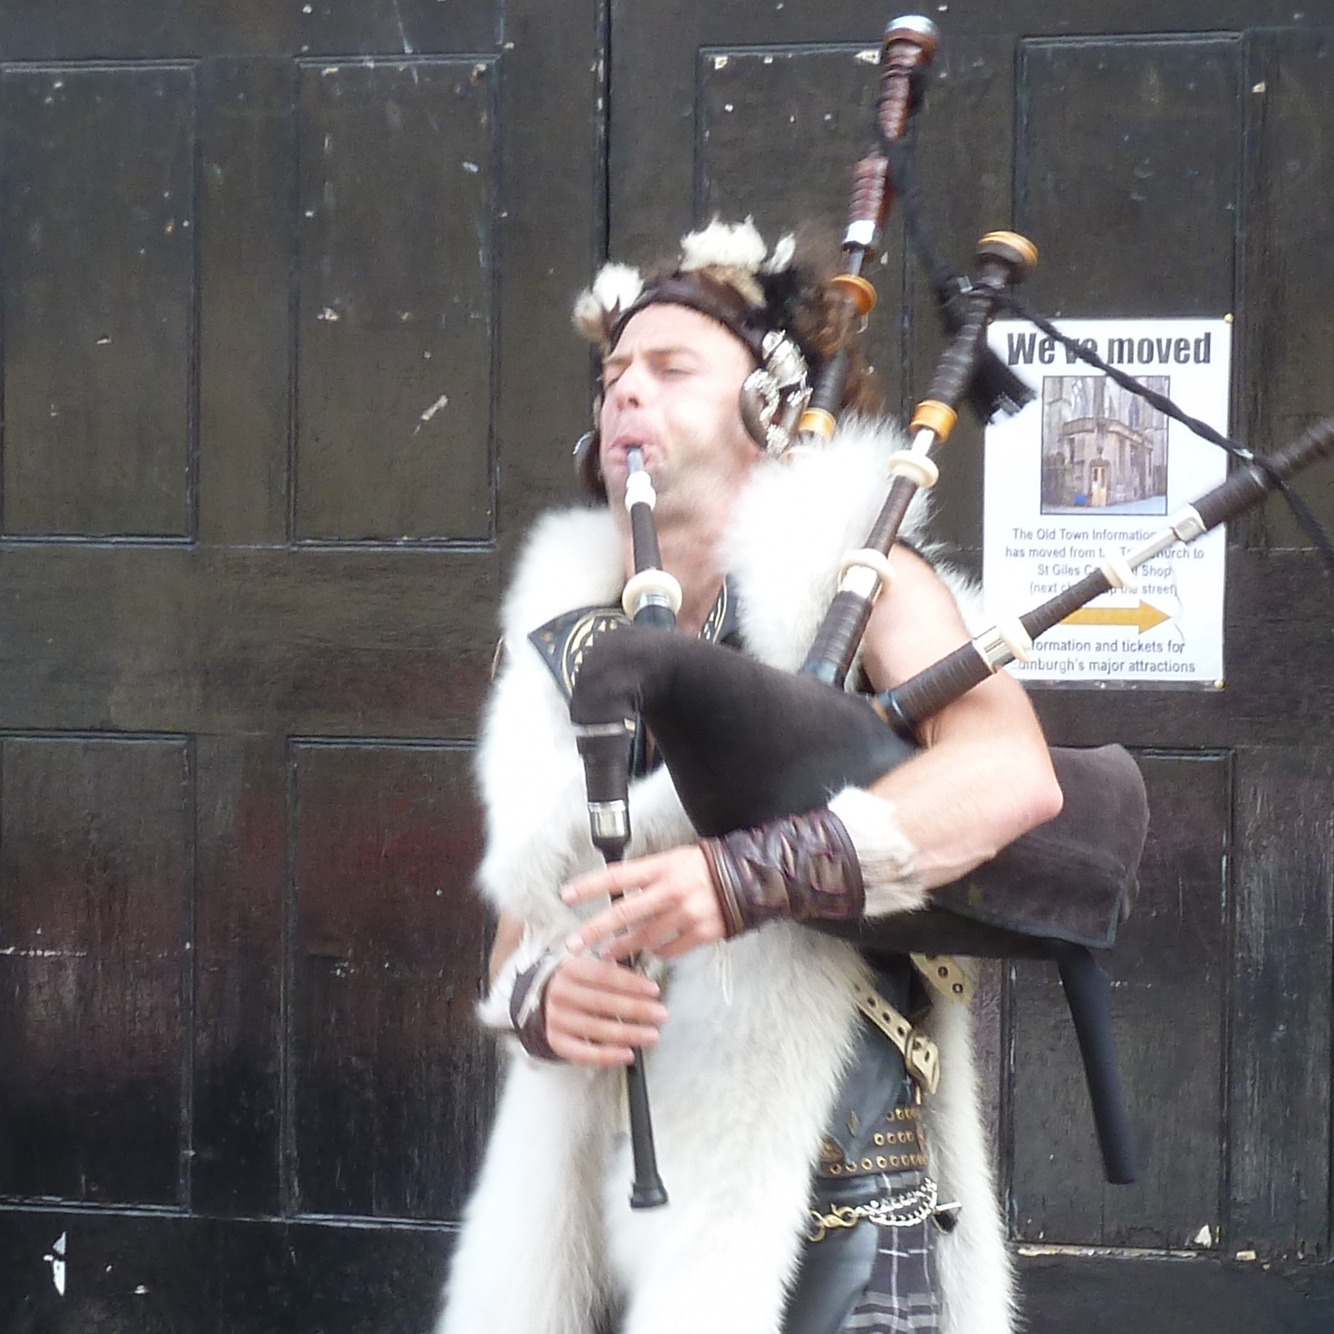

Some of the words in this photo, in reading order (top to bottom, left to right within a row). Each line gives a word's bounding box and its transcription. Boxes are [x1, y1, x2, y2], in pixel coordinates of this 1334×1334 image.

[1007, 332, 1099, 366] Weve
[1107, 332, 1211, 365] moved
[1013, 528, 1033, 540] The
[1037, 528, 1056, 540] Old
[1060, 528, 1089, 541] Town
[1005, 545, 1025, 558] has
[1029, 546, 1066, 558] moved
[1070, 546, 1095, 558] from
[1152, 547, 1190, 559] hurch
[1194, 548, 1205, 559] to
[1038, 563, 1049, 576] St
[1053, 563, 1081, 576] Giles
[1142, 564, 1171, 579] Shop
[1030, 581, 1057, 596] (next
[1031, 640, 1091, 652] formation
[1095, 640, 1118, 652] and
[1122, 639, 1163, 653] tickets
[1168, 640, 1185, 654] for
[1089, 658, 1125, 675] major
[1129, 659, 1195, 673] attractions
